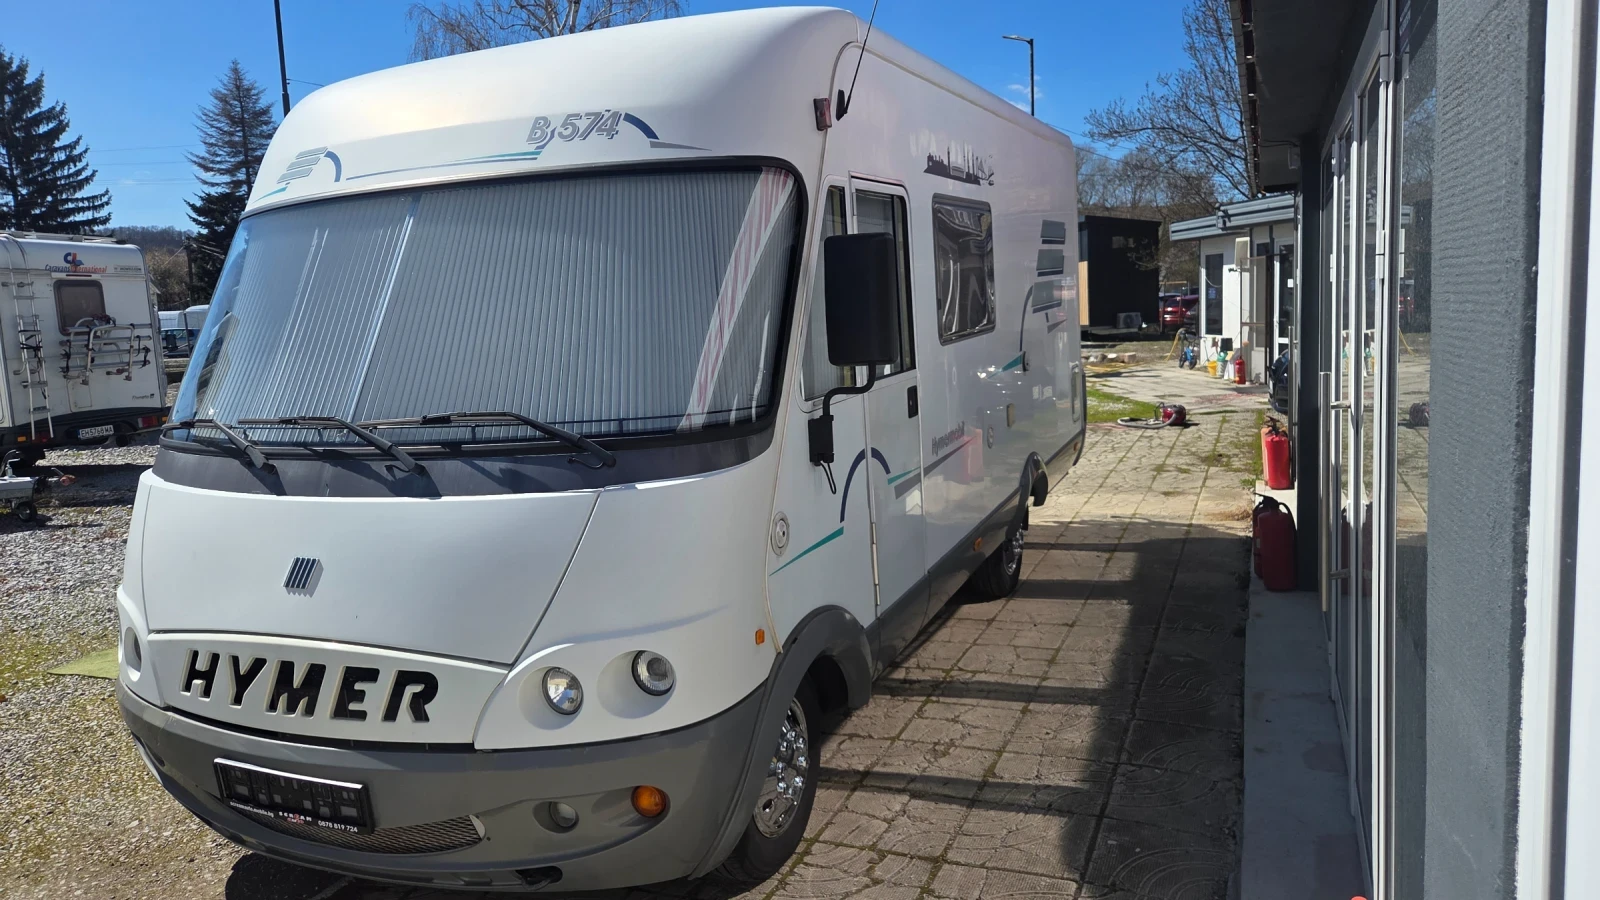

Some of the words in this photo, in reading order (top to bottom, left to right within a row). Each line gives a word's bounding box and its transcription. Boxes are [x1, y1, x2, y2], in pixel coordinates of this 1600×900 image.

[526, 116, 551, 145] B
[557, 109, 622, 142] 574
[44, 263, 71, 273] Caravans
[70, 264, 107, 274] International
[179, 648, 439, 723] HYMER
[317, 820, 333, 829] 0878
[346, 825, 358, 833] 724
